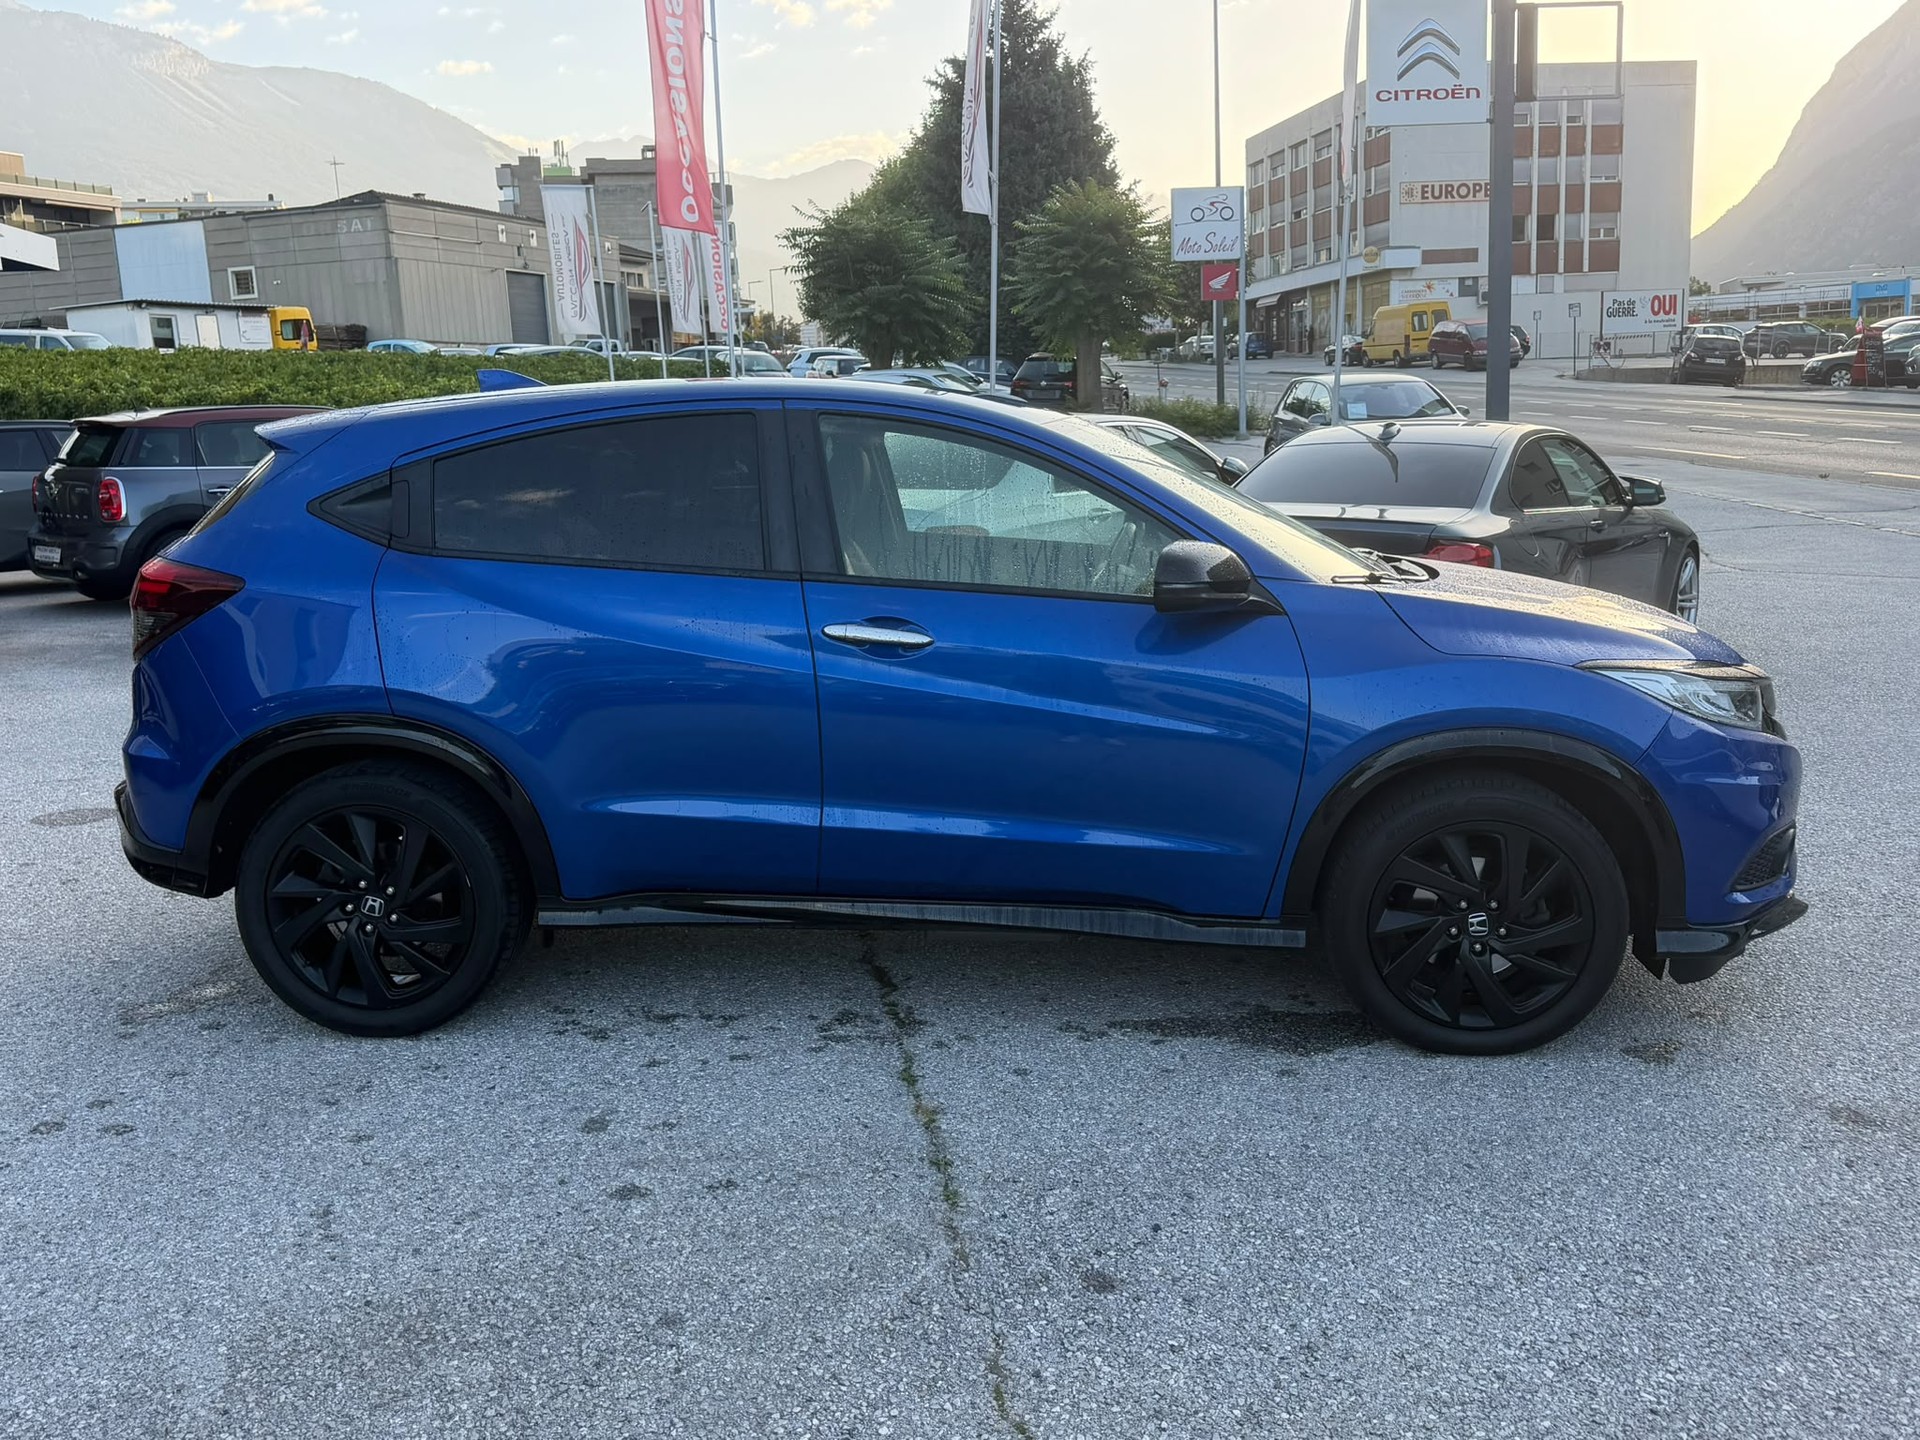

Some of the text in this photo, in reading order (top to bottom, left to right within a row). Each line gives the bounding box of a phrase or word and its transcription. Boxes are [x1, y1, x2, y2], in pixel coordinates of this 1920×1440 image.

[1176, 231, 1239, 256] Moto Soleil
[1612, 298, 1636, 307] Pas de
[1650, 294, 1678, 316] OUI
[1606, 306, 1638, 318] GUERRE.
